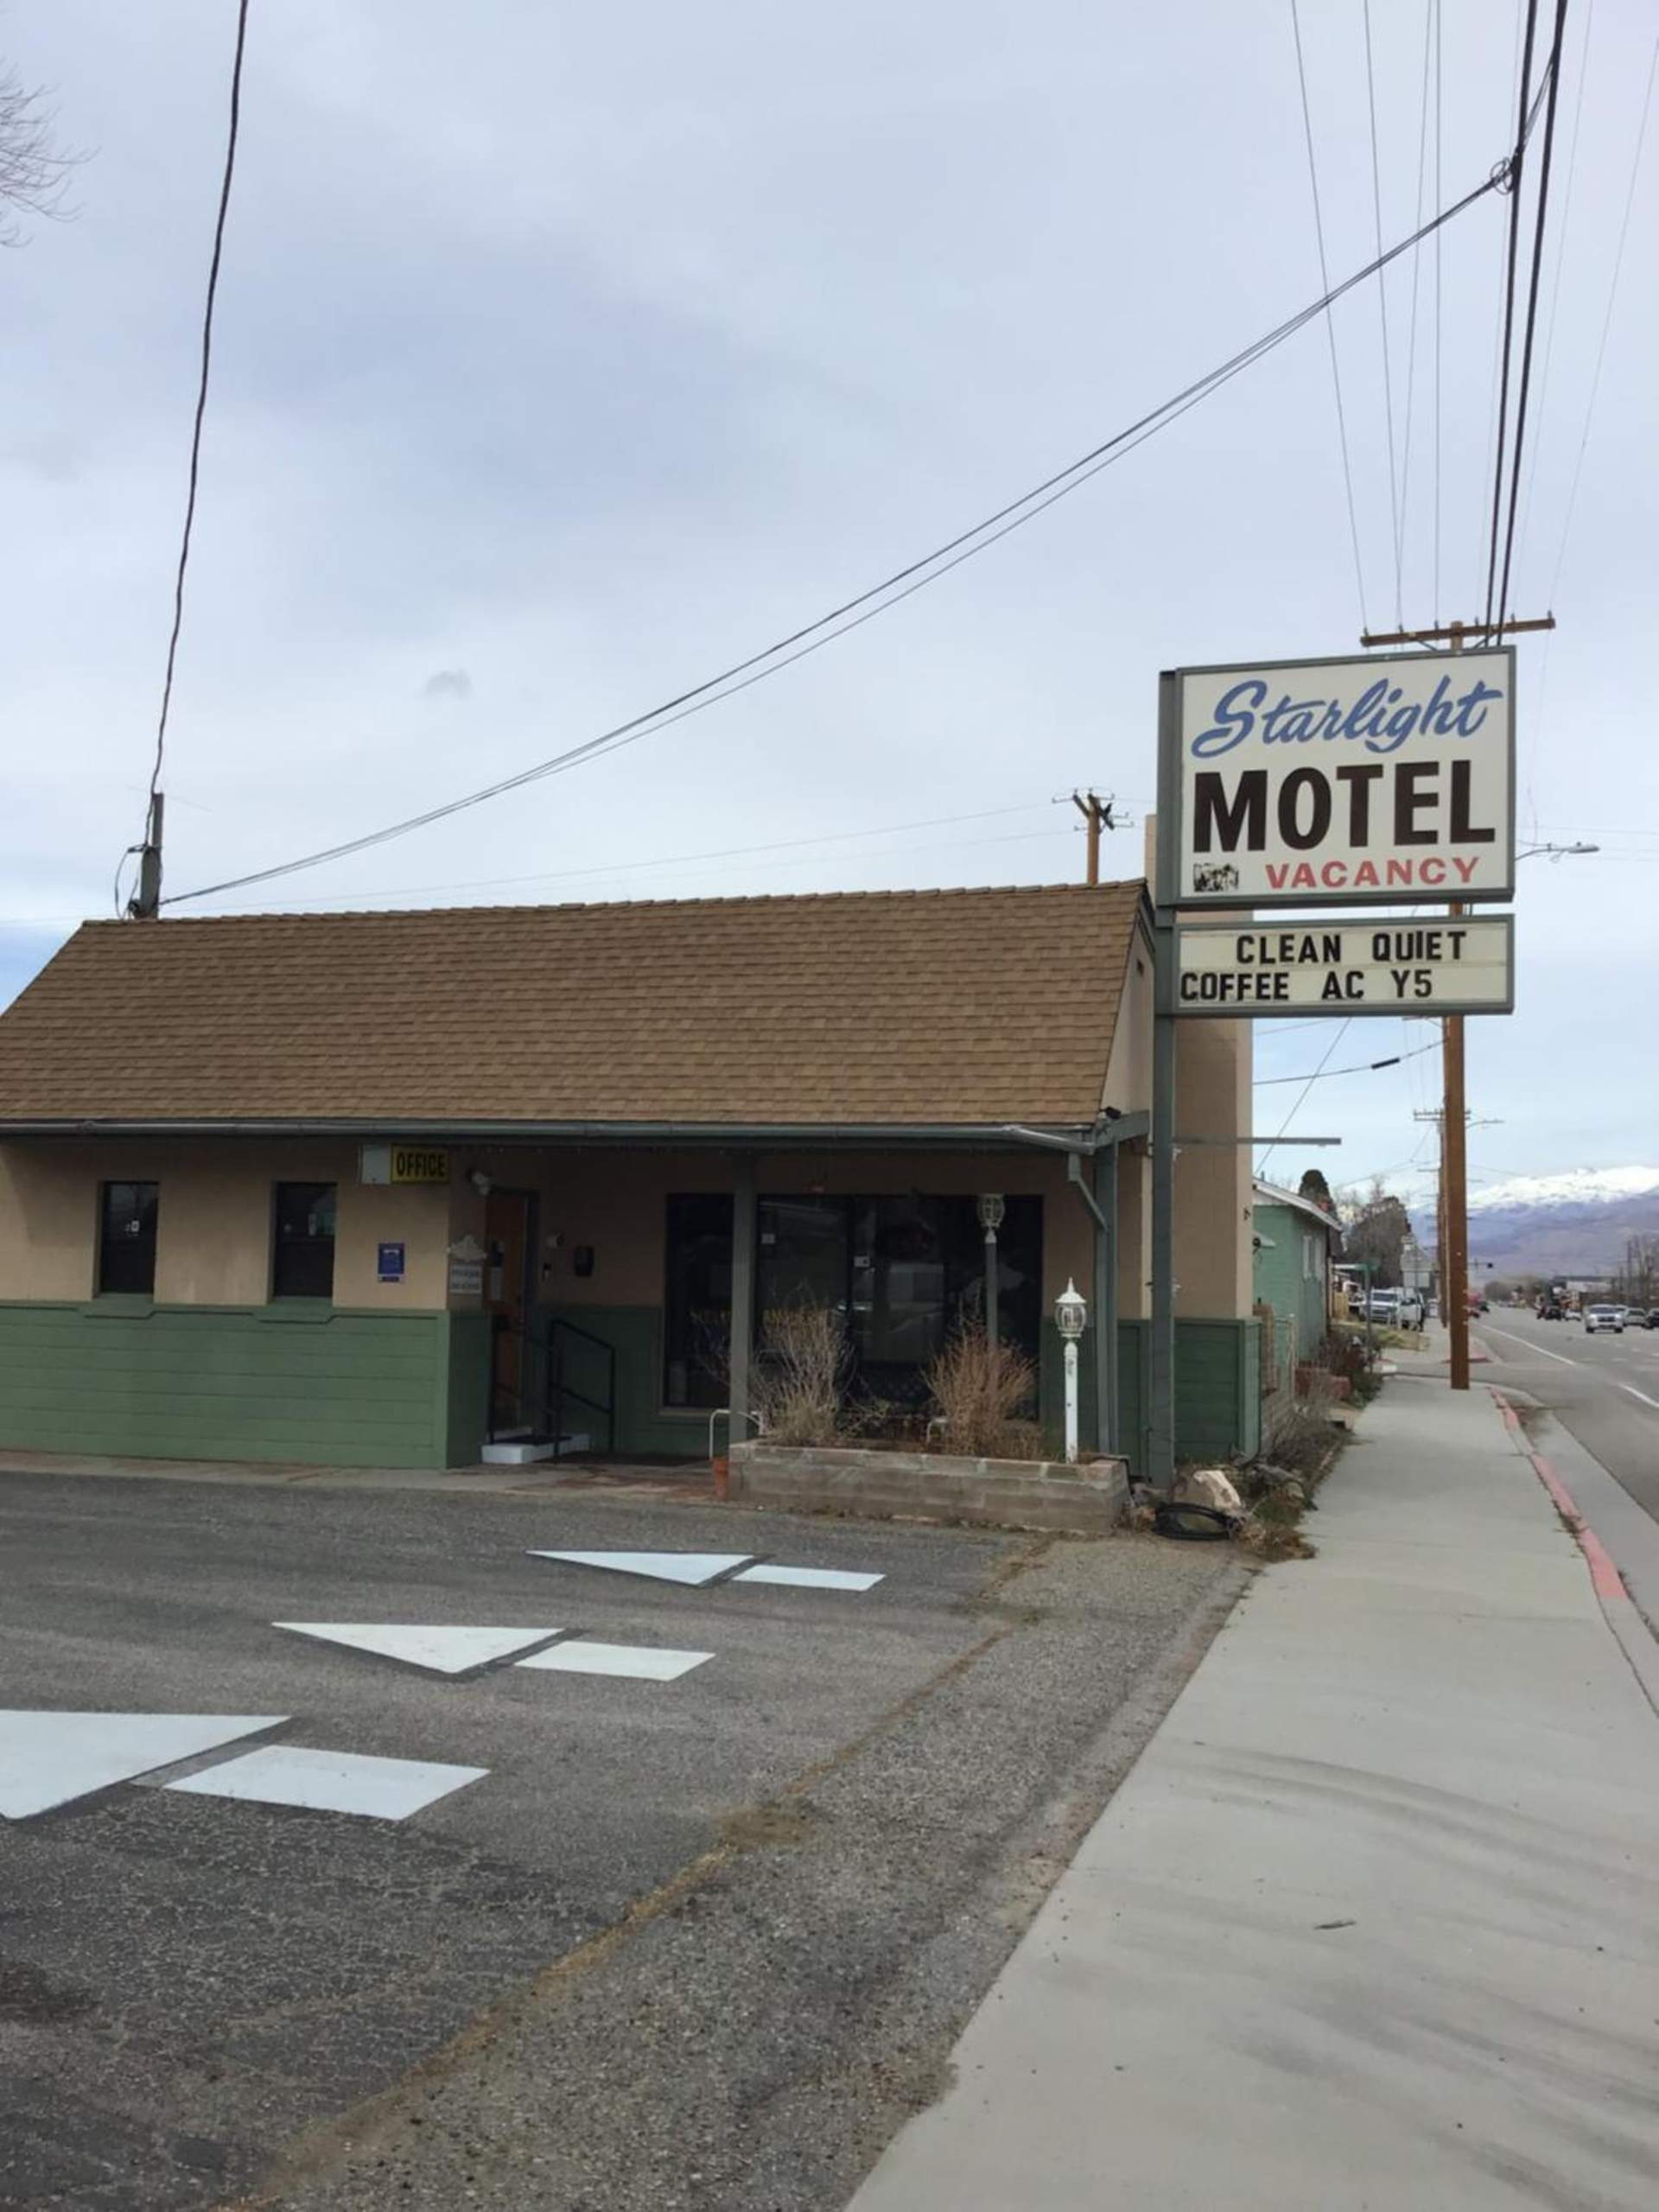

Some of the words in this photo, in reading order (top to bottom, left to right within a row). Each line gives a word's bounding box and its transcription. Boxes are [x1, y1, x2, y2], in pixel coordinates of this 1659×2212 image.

[1191, 675, 1503, 759] Starlight
[1193, 760, 1496, 853] MOTEL
[1265, 856, 1479, 889] VACANCY
[1236, 934, 1342, 964] CLEAN
[1372, 931, 1466, 962] QUIET
[1180, 972, 1289, 1001] COFFEE
[1321, 970, 1364, 1000] AC
[1391, 969, 1433, 999] Y5
[397, 1152, 445, 1177] OFFICE
